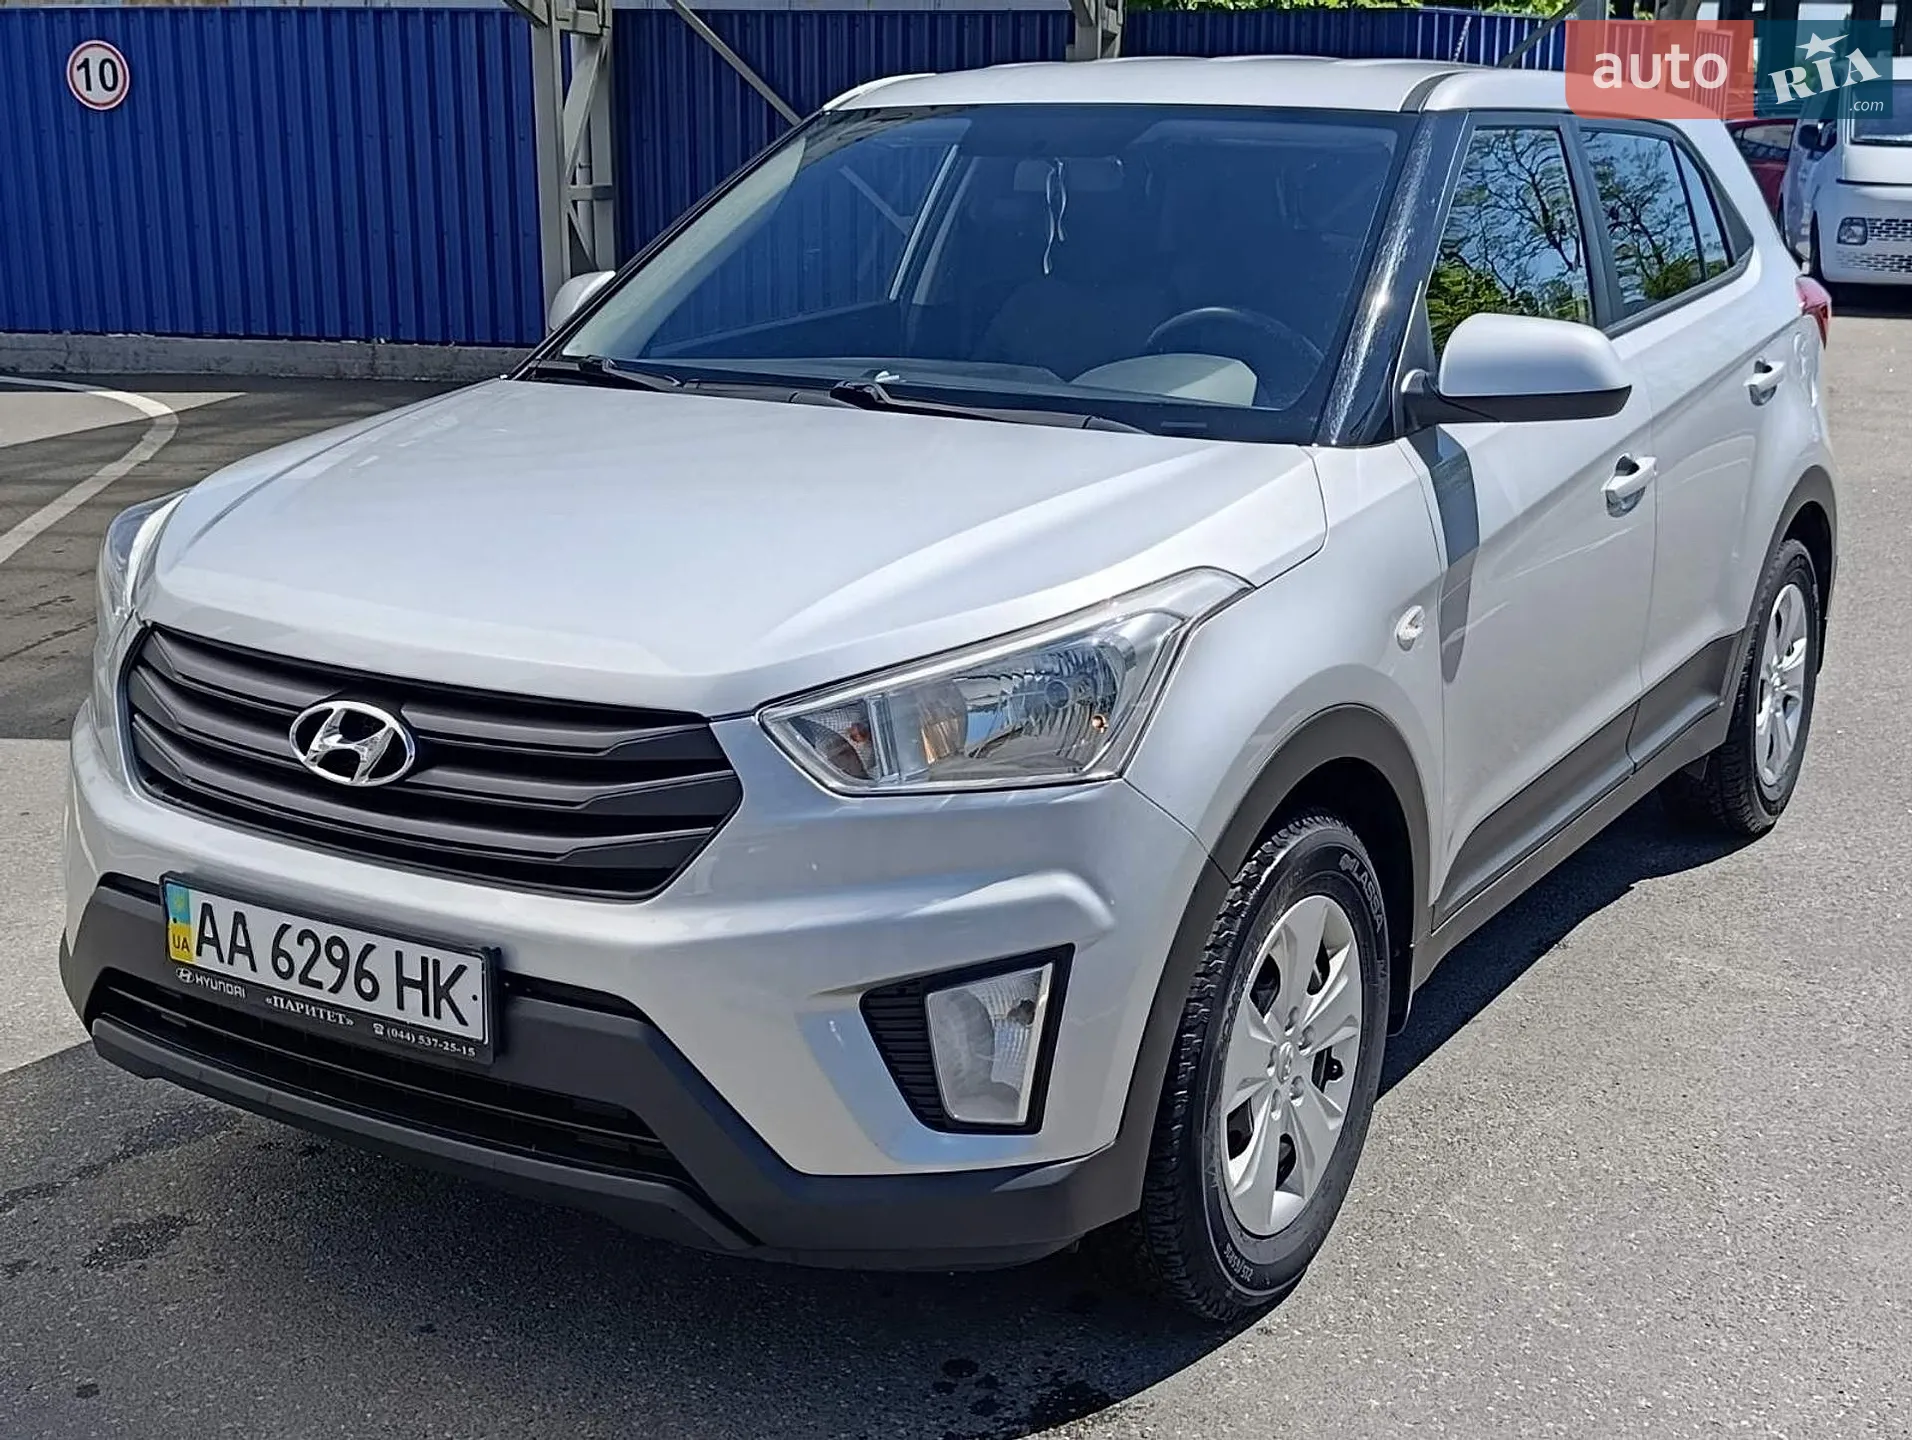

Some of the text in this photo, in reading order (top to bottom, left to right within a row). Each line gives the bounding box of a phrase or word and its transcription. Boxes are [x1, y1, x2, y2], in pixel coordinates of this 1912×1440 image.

[76, 57, 119, 92] 10
[171, 933, 191, 953] UA
[195, 901, 470, 1027] AA 6296 HK
[194, 973, 247, 999] HYUNDAI
[386, 1026, 476, 1058] (044) 537-25-15
